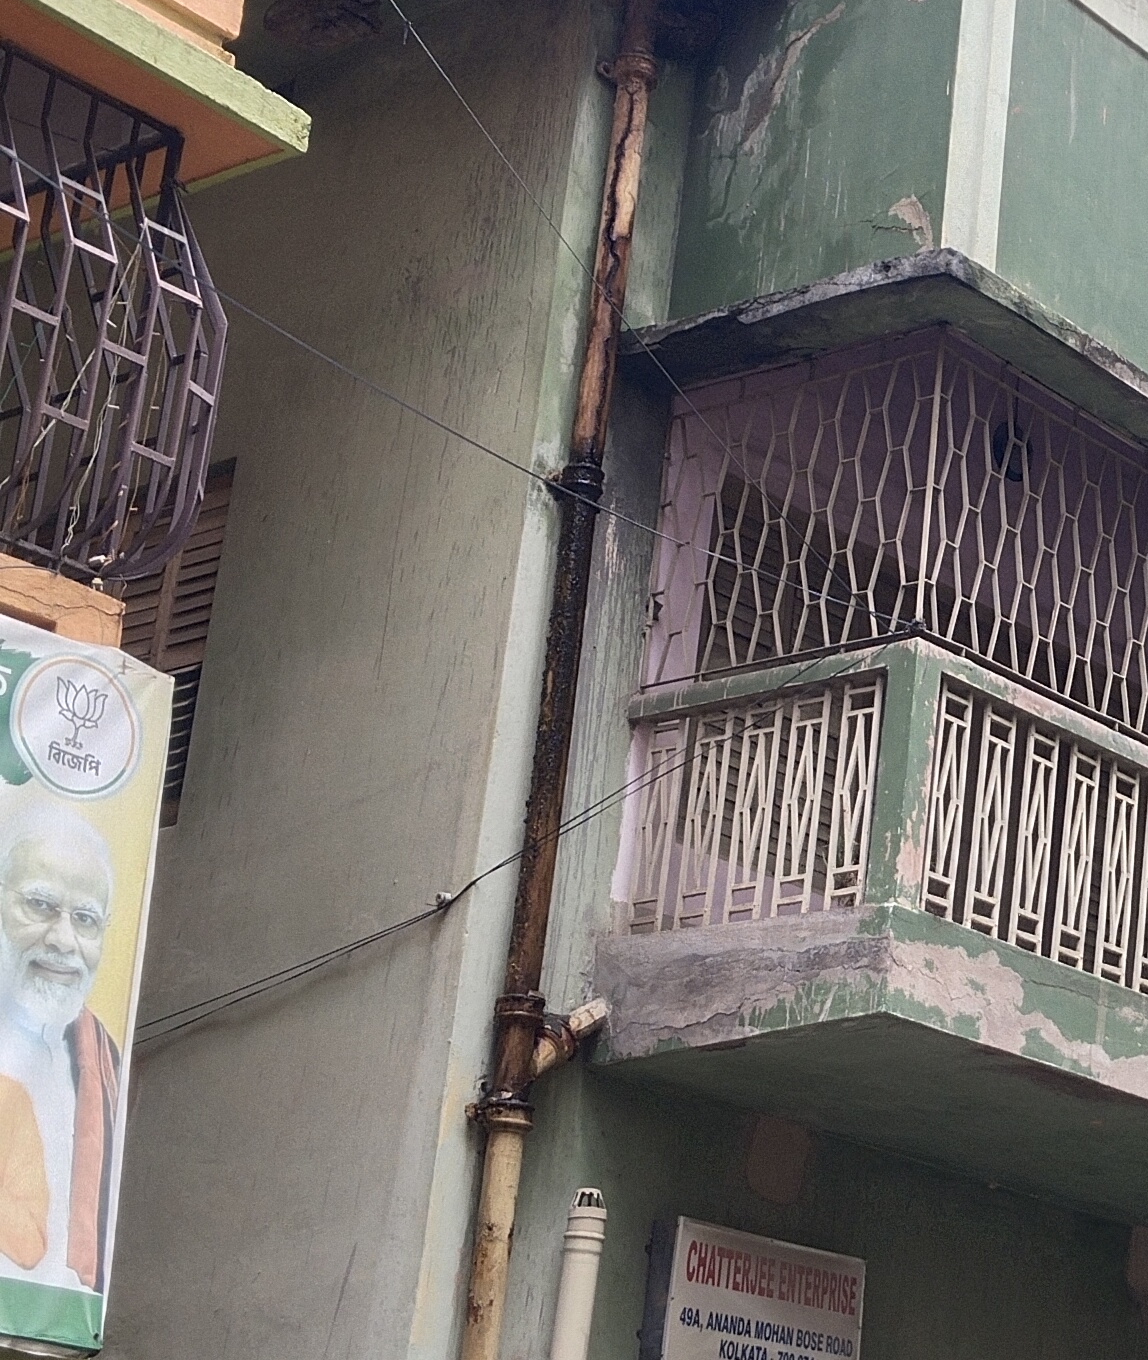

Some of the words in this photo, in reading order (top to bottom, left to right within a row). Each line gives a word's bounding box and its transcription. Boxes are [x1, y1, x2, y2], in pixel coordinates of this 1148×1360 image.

[48, 741, 101, 776] বিজেপি
[686, 1240, 775, 1299] CHATTERJEE
[777, 1260, 858, 1316] ENTERPRISE
[679, 1307, 703, 1332] 49A,
[706, 1311, 752, 1338] ANANDA
[754, 1321, 794, 1347] MOHAN
[796, 1329, 823, 1352] BOSE
[825, 1334, 853, 1358] ROAD
